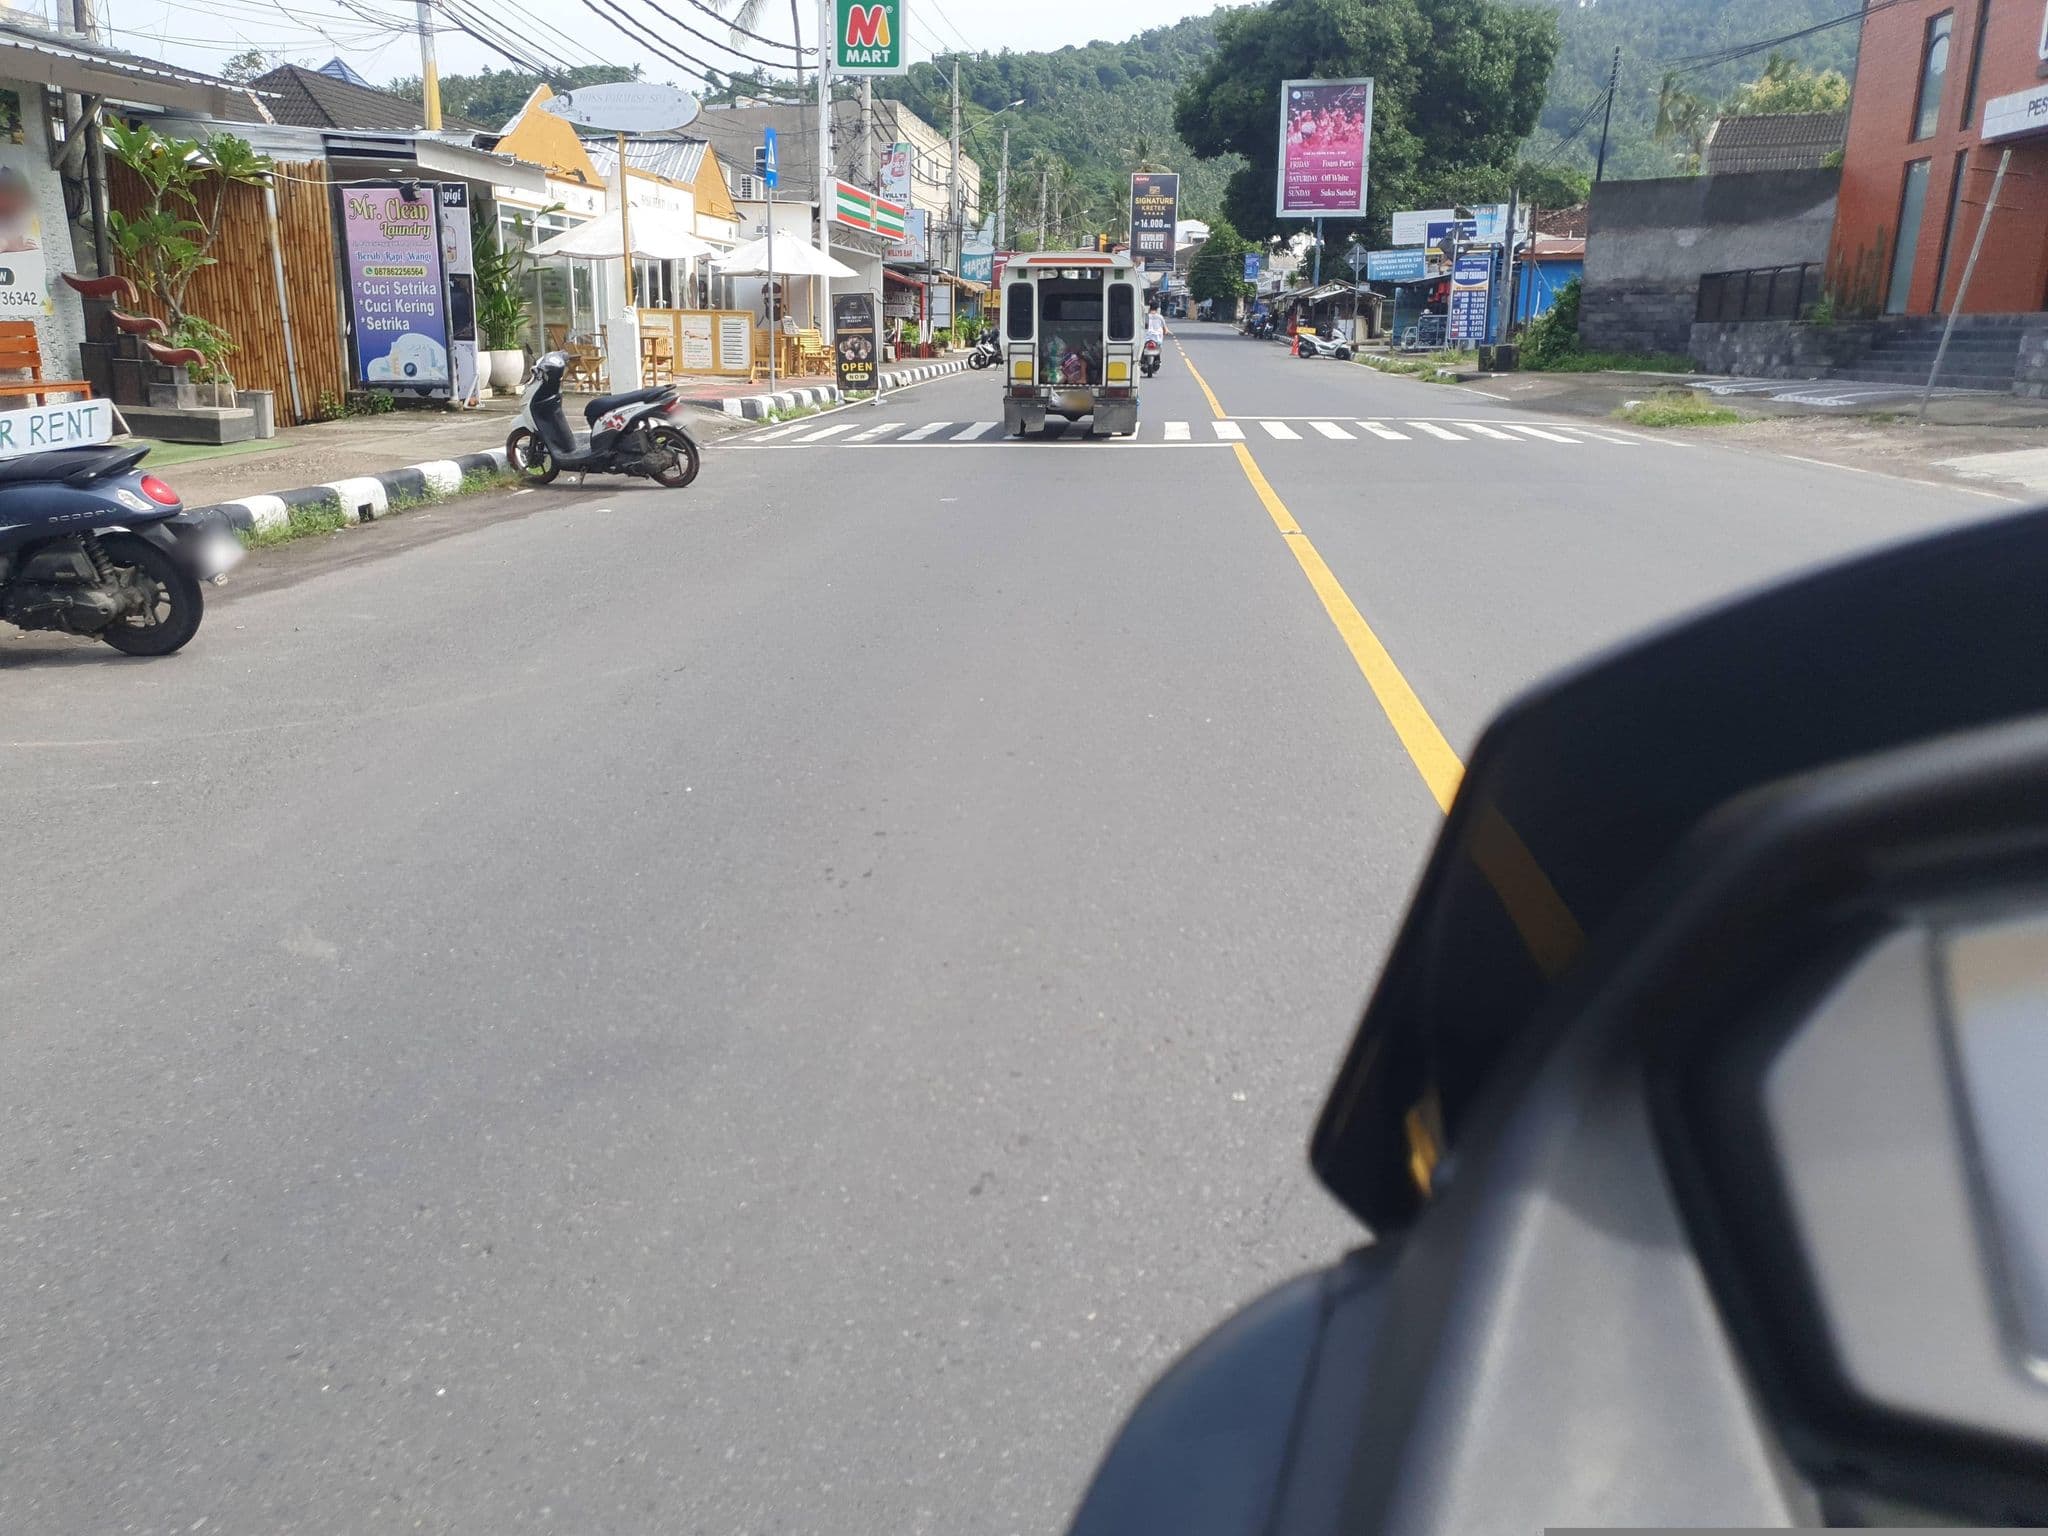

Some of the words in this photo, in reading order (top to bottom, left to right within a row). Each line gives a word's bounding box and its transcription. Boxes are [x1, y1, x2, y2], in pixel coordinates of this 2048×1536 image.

[846, 49, 891, 63] MART
[1339, 159, 1355, 169] Party
[1288, 189, 1311, 197] SUNDAY
[1336, 188, 1357, 198] Sunday
[1135, 197, 1174, 205] SIGNATURE
[349, 194, 382, 220] Mr.
[385, 197, 429, 223] Clean
[380, 221, 432, 240] Laundry
[1140, 219, 1164, 228] 16.000
[393, 281, 436, 295] Setrika
[1, 291, 38, 306] 36342
[395, 298, 435, 316] Kering
[841, 362, 873, 372] OPEN
[30, 407, 99, 446] RENT
